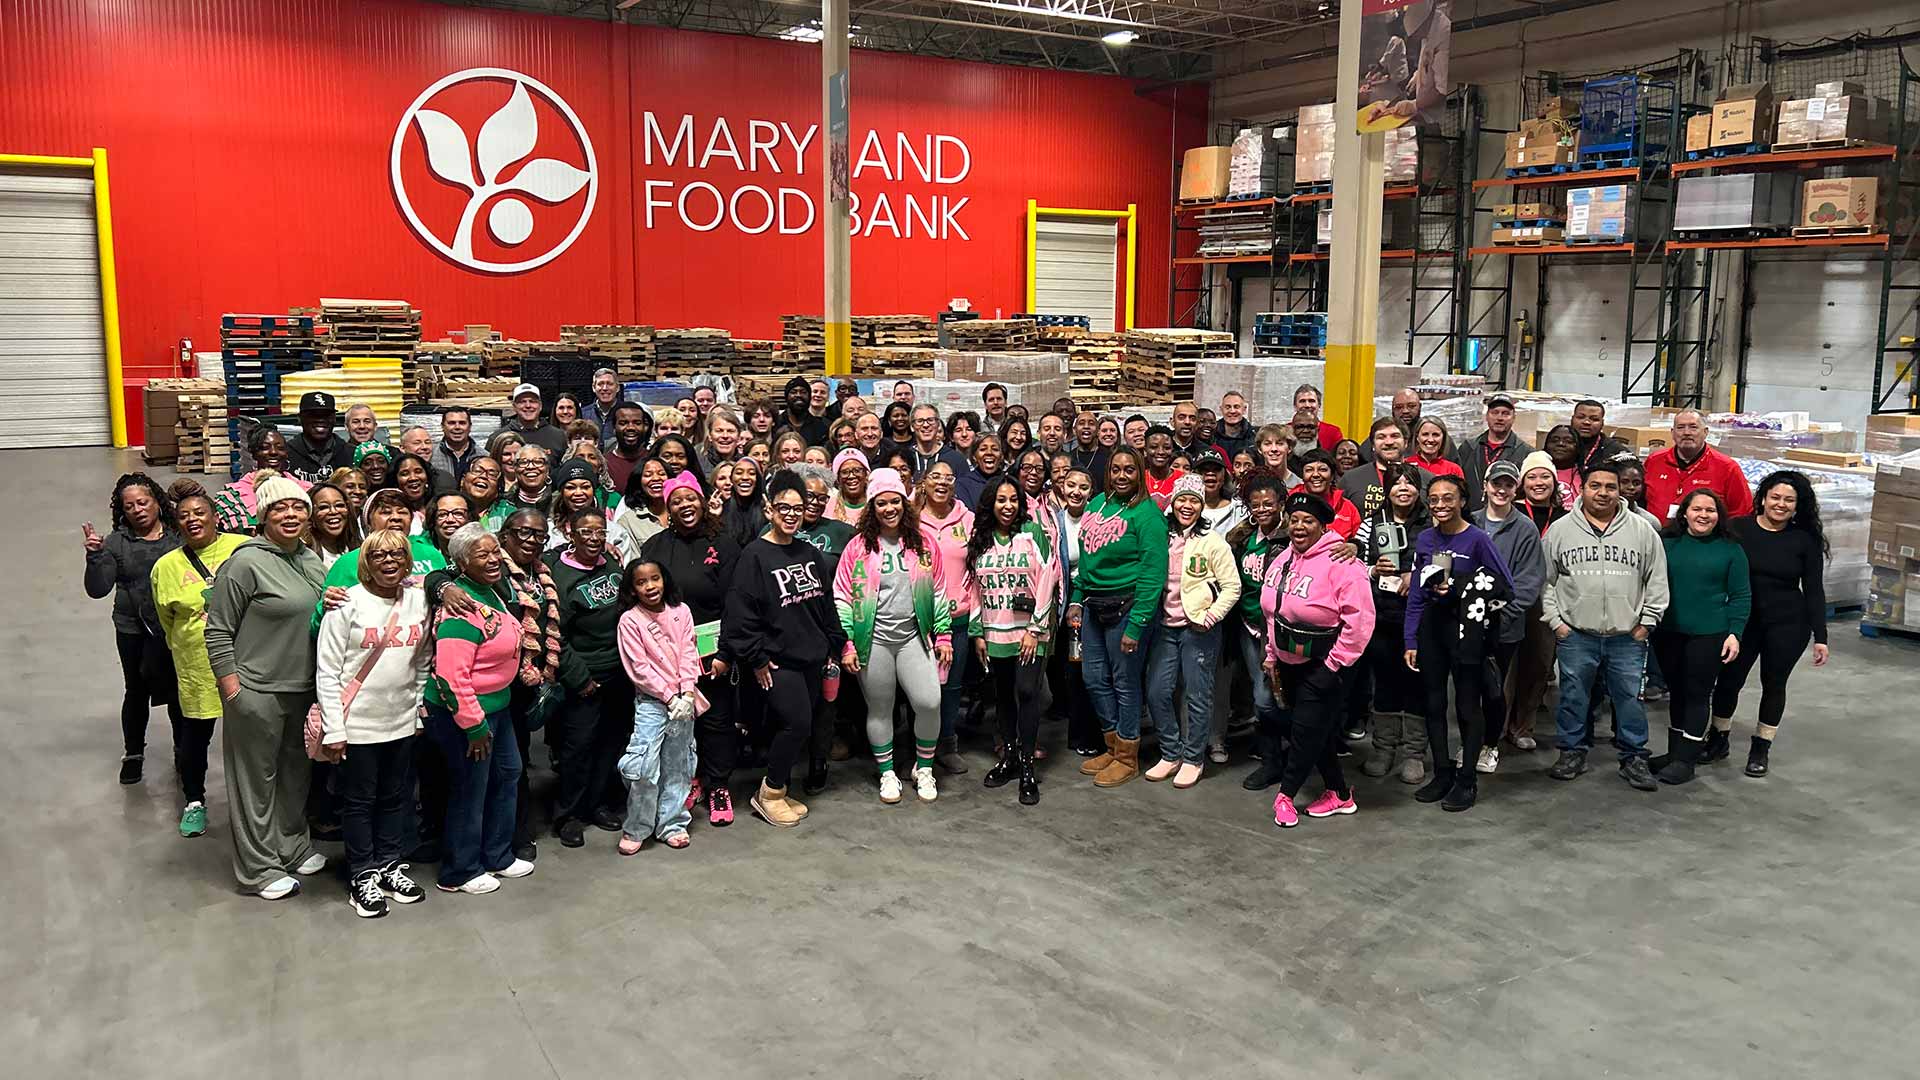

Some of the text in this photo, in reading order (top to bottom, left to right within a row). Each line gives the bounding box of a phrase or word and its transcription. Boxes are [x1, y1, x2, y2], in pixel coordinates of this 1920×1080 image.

[644, 112, 970, 184] MARYAND
[645, 180, 815, 234] FOOD
[1821, 357, 1833, 376] 5
[1197, 450, 1223, 461] AKA
[976, 553, 1030, 569] ALPHA
[977, 573, 1029, 589] KAPPA
